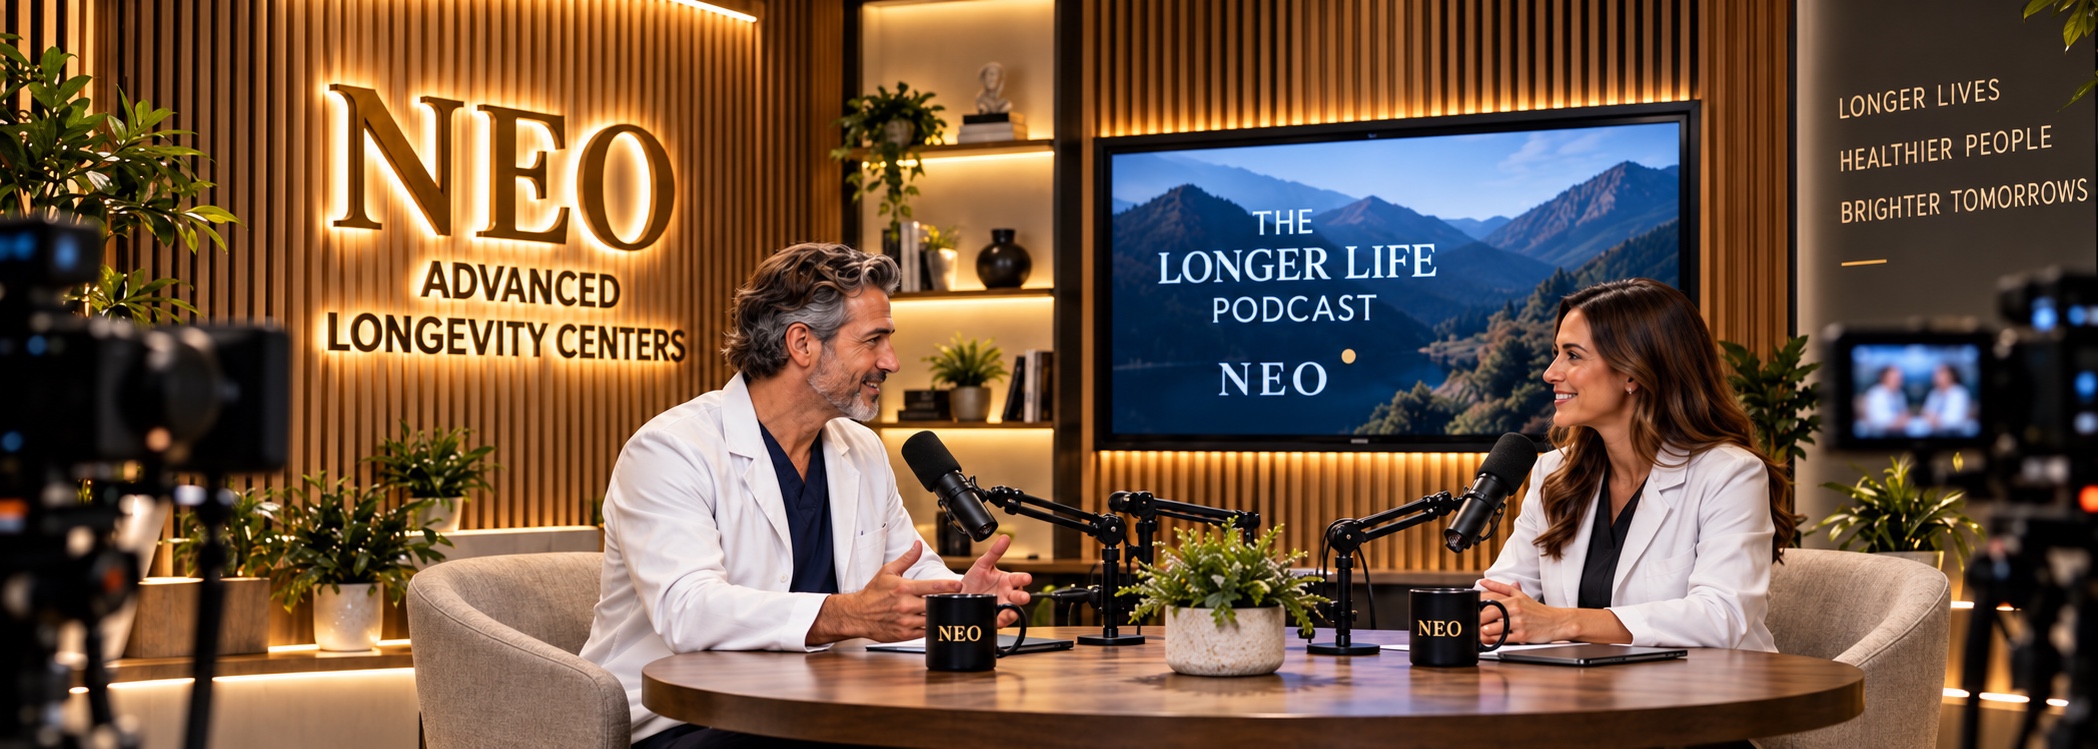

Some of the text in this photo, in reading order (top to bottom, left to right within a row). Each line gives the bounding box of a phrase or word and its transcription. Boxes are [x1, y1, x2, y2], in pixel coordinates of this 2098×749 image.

[1839, 78, 2001, 119] LONGER LIVES
[328, 83, 676, 252] NEO
[1840, 125, 2052, 172] HEALTHIER PEOPLE
[1841, 178, 2088, 224] BRIGHTER TOMORROWS
[1252, 209, 1313, 236] THE
[420, 260, 621, 308] ADVANCED
[1158, 243, 1437, 285] LONGER LIFE
[1212, 294, 1377, 323] PODCAST
[327, 312, 686, 362] LONGEVITY CENTERS
[1218, 362, 1328, 396] NEO
[938, 625, 982, 642] NEO
[1418, 620, 1462, 637] NEO
